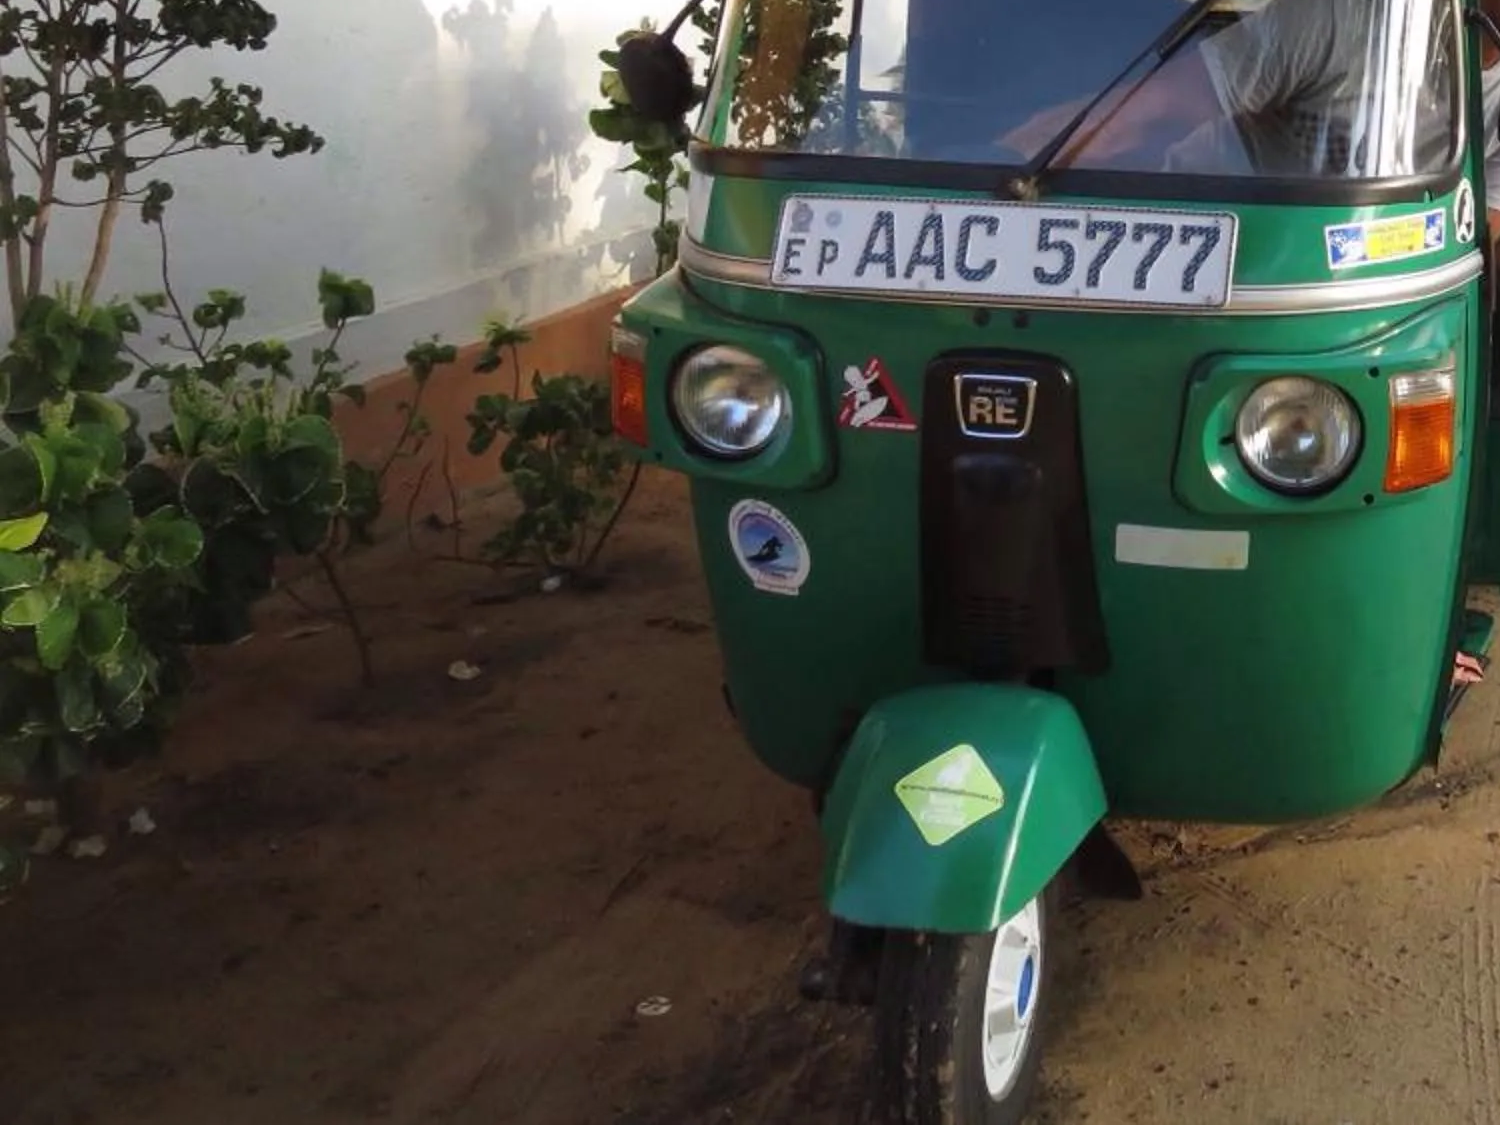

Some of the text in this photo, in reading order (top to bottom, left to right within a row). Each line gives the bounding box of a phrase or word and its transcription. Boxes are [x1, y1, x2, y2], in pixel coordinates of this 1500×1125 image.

[854, 210, 1001, 281] AAC
[1032, 217, 1221, 292] 5777
[969, 395, 1018, 424] RE
